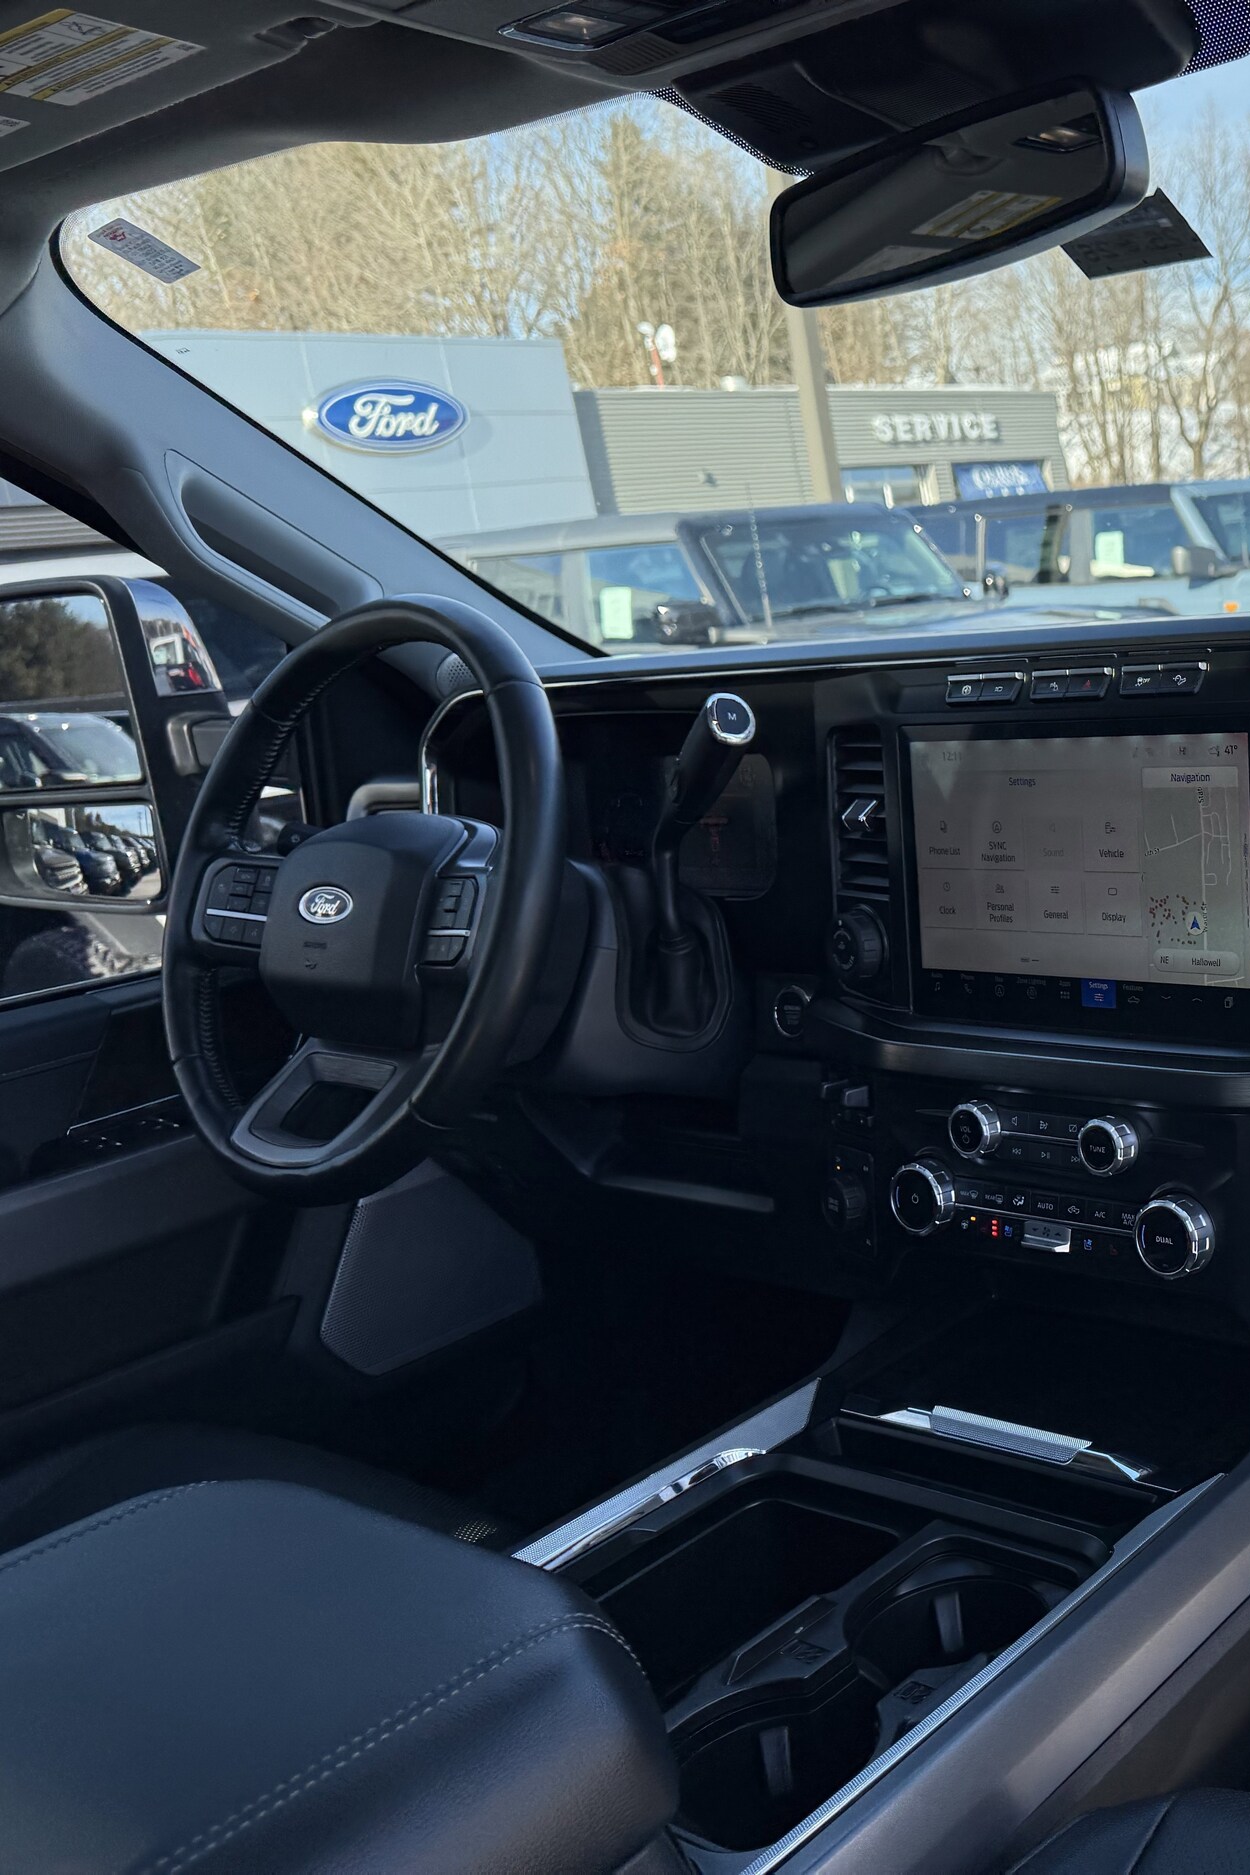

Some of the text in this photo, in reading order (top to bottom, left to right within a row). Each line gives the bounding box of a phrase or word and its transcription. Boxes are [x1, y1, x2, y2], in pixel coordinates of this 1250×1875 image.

[350, 392, 439, 441] Ford
[872, 413, 999, 441] SERVICE
[727, 712, 737, 721] M
[1008, 777, 1036, 787] Settings
[1171, 774, 1211, 783] Navigation
[989, 840, 1007, 850] SYNC
[929, 846, 960, 856] Phone List
[1099, 849, 1125, 858] Vehicle
[981, 854, 1015, 863] Navigation
[309, 894, 341, 916] Ford
[987, 902, 1014, 911] Personal
[939, 906, 956, 915] Clock
[989, 914, 1013, 923] Profiles
[1043, 911, 1069, 920] General
[1101, 912, 1126, 923] Display
[1160, 956, 1169, 965] NE
[1191, 957, 1221, 967] Hallowell
[1089, 981, 1109, 991] Settings
[960, 1125, 972, 1134] VOL
[1089, 1144, 1106, 1154] TUNE
[1037, 1202, 1054, 1211] AUTO
[1094, 1211, 1106, 1219] A/C
[1155, 1235, 1174, 1246] DUAL
